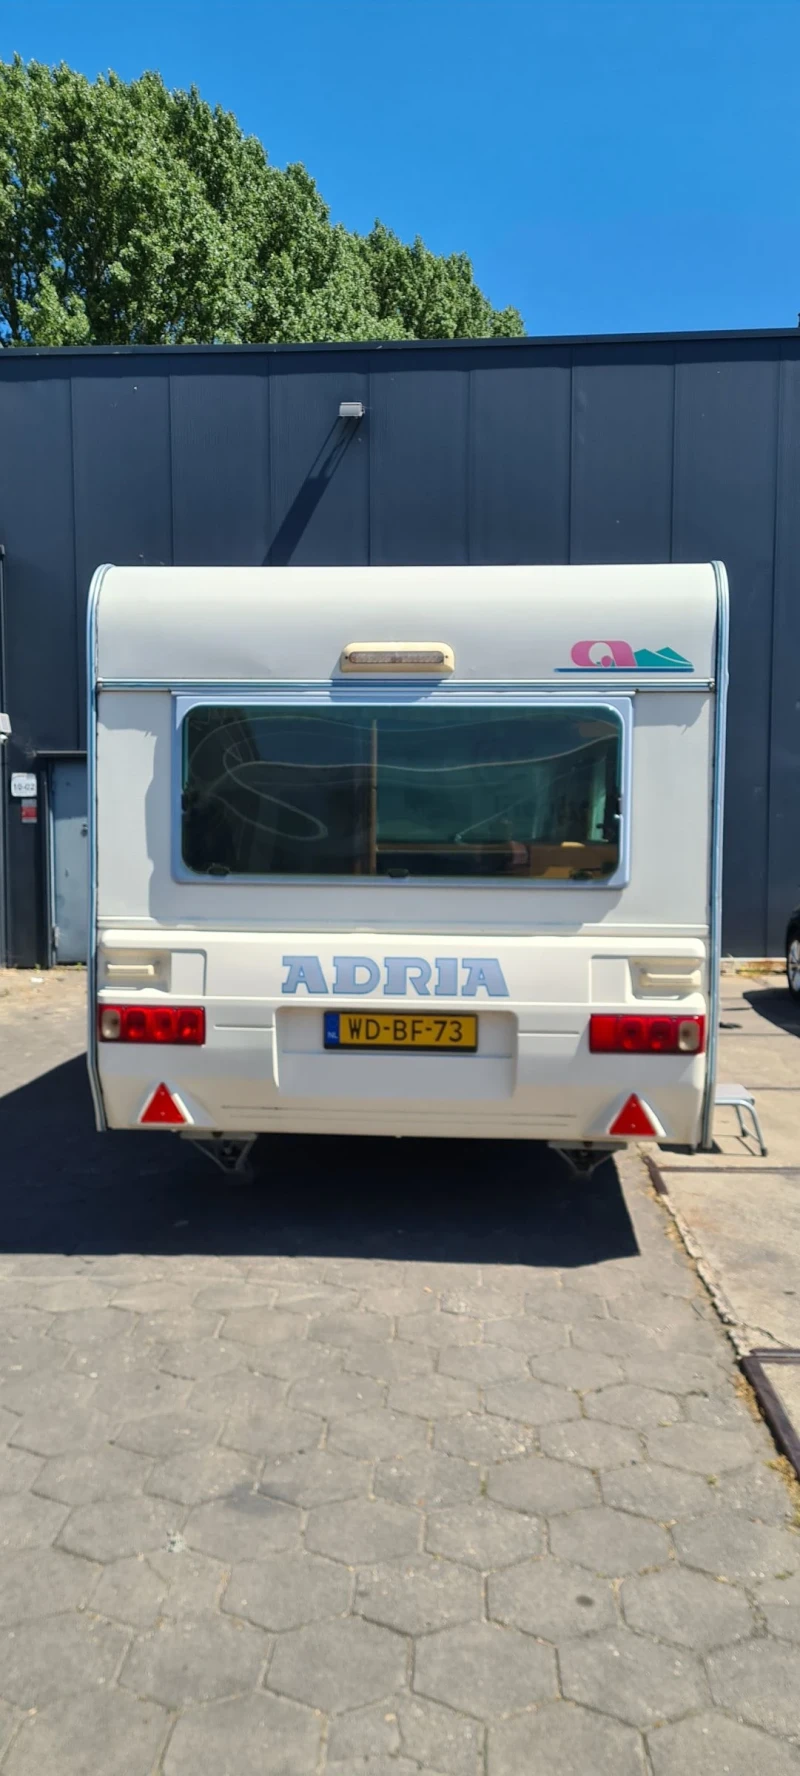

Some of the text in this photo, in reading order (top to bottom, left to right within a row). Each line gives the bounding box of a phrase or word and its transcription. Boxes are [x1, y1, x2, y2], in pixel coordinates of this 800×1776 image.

[281, 955, 510, 997] ADRIA
[327, 1031, 338, 1039] NL
[348, 1017, 464, 1043] WD-BF-73
